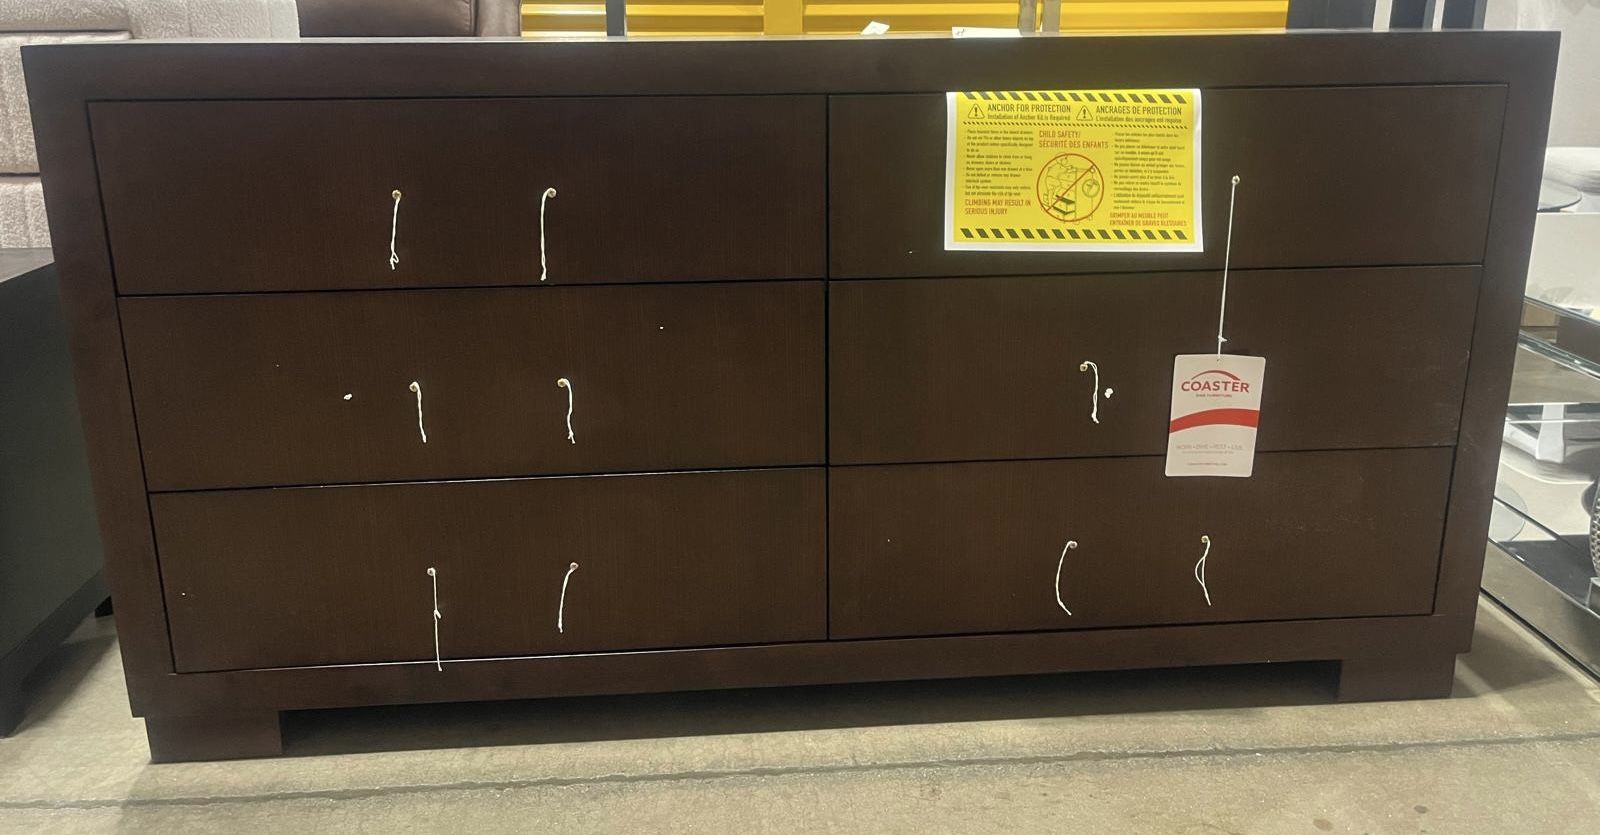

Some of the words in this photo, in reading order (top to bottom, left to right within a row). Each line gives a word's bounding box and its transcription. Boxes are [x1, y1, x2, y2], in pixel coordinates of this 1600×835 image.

[988, 104, 1014, 112] ANCHOR
[1016, 104, 1029, 112] FOR
[1031, 104, 1071, 112] PROTECTION
[1096, 106, 1130, 114] ANCRAGES
[1142, 106, 1182, 116] PROTECTION
[1069, 140, 1081, 149] DES
[1082, 141, 1109, 149] ENFANTS
[1181, 381, 1250, 393] COASTER
